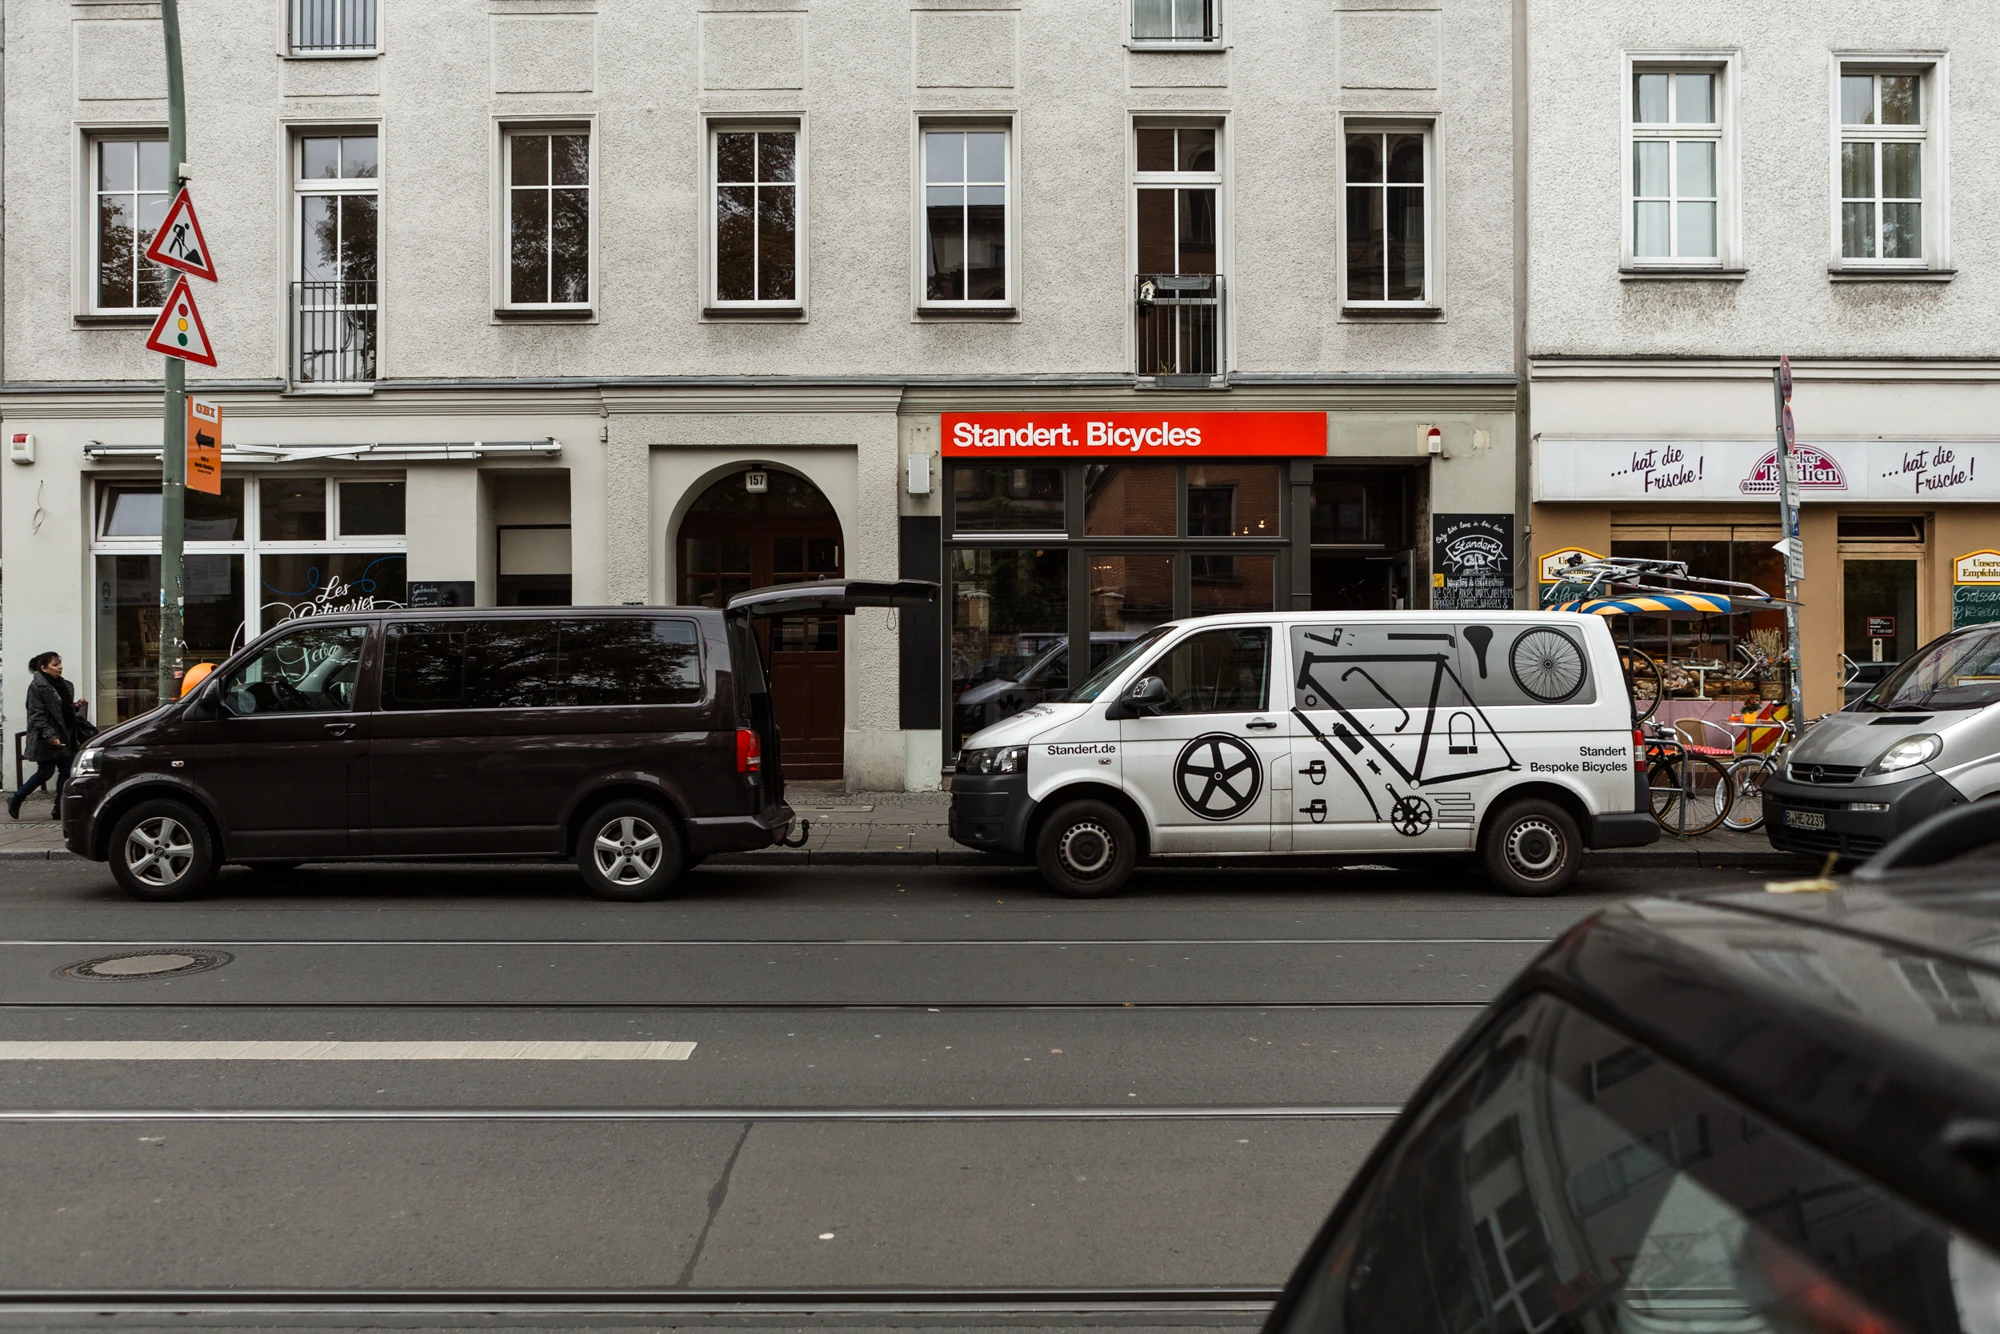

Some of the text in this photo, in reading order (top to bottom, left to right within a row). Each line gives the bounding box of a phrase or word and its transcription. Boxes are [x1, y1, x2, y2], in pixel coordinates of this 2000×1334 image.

[195, 403, 216, 418] OBI
[952, 421, 1202, 451] Standert. Bicycles
[1662, 445, 1684, 466] die
[1932, 446, 1955, 467] die
[748, 474, 765, 486] 157
[1762, 464, 1836, 482] Tadien
[1453, 538, 1498, 555] Standert
[316, 575, 352, 604] Les
[1047, 743, 1116, 755] Standert.de
[1579, 746, 1627, 757] Standert
[1530, 761, 1628, 774] Bespoke Bicycles
[1805, 813, 1824, 828] 2239
